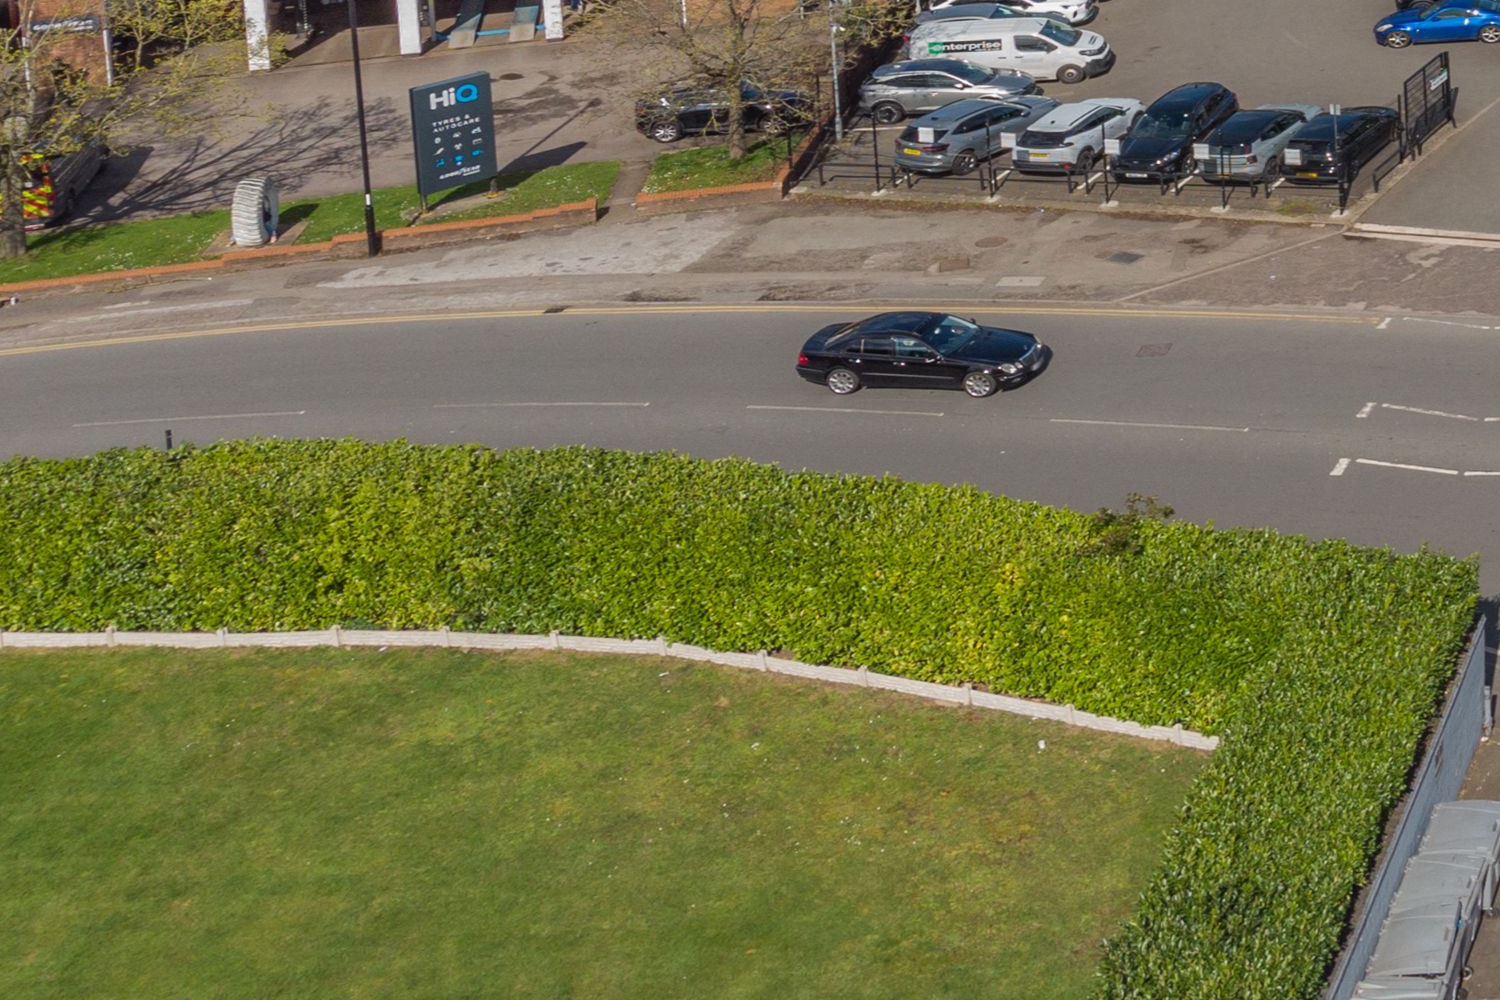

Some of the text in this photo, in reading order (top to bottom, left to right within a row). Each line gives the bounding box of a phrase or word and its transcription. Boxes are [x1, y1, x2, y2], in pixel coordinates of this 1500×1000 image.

[930, 40, 1001, 53] enterprise
[429, 83, 479, 110] HiQ
[431, 116, 461, 127] TYRES
[433, 117, 480, 133] AUTOCARE
